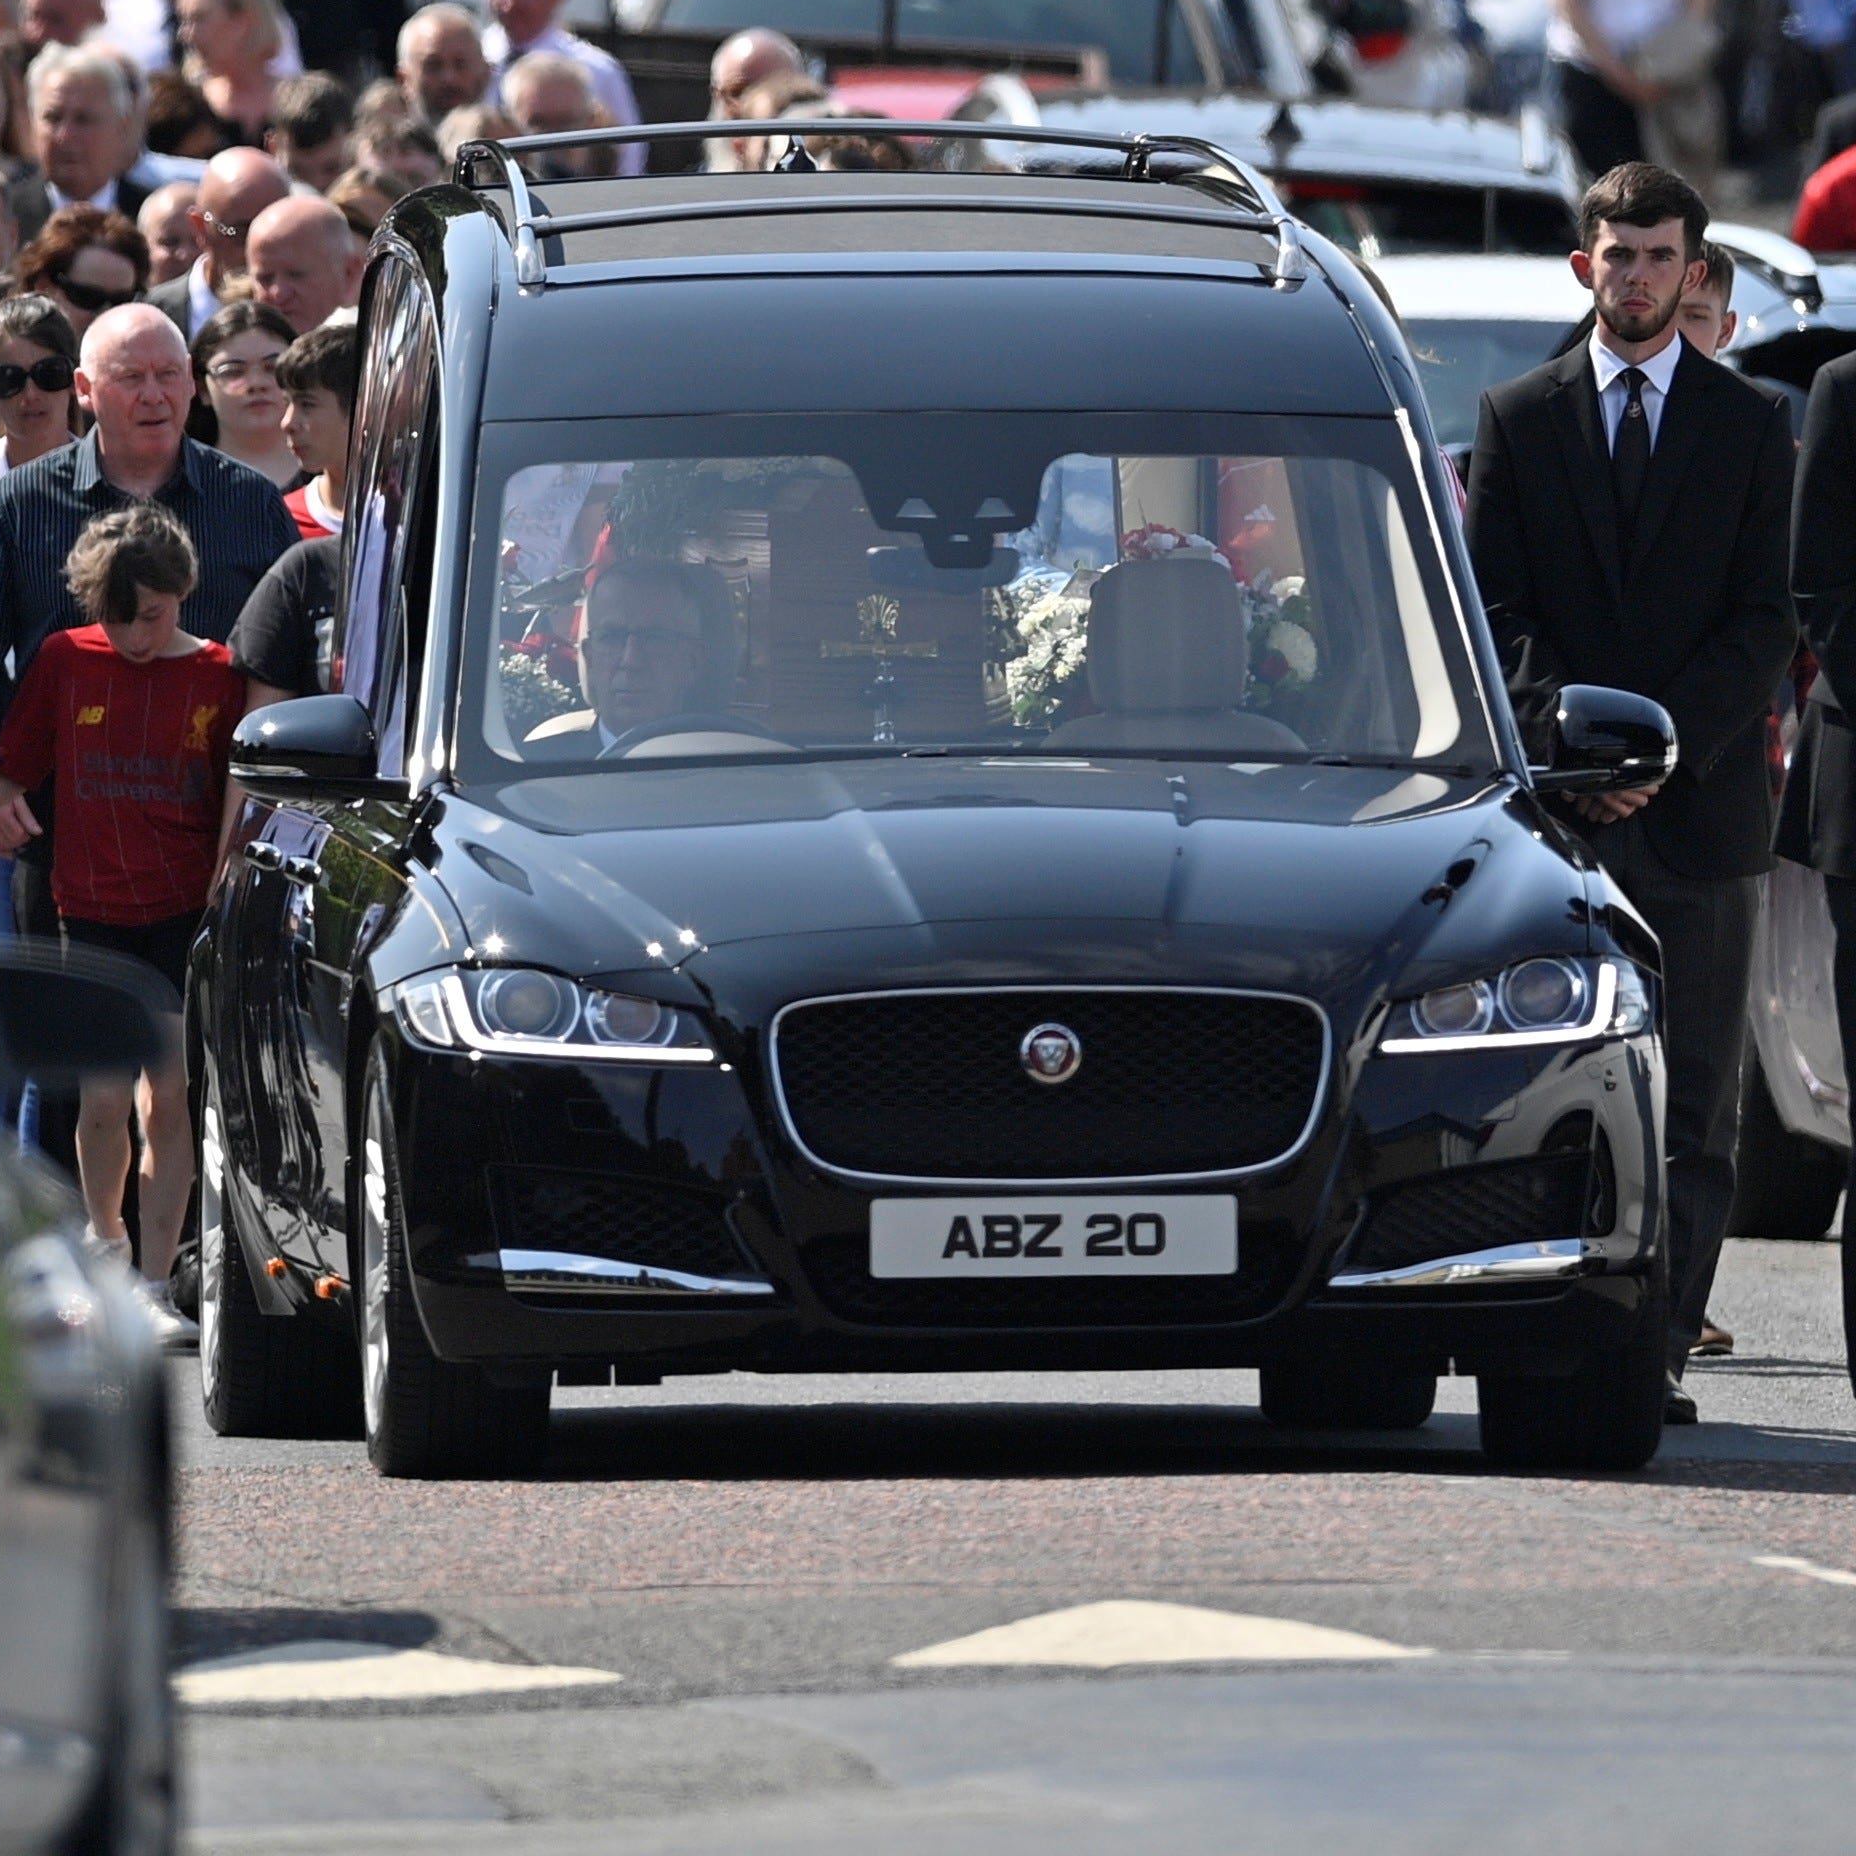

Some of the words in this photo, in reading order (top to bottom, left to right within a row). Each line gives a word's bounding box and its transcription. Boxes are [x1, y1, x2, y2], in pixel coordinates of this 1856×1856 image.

[76, 705, 105, 725] NB
[942, 1214, 1064, 1259] ABZ
[1085, 1213, 1166, 1257] 20
